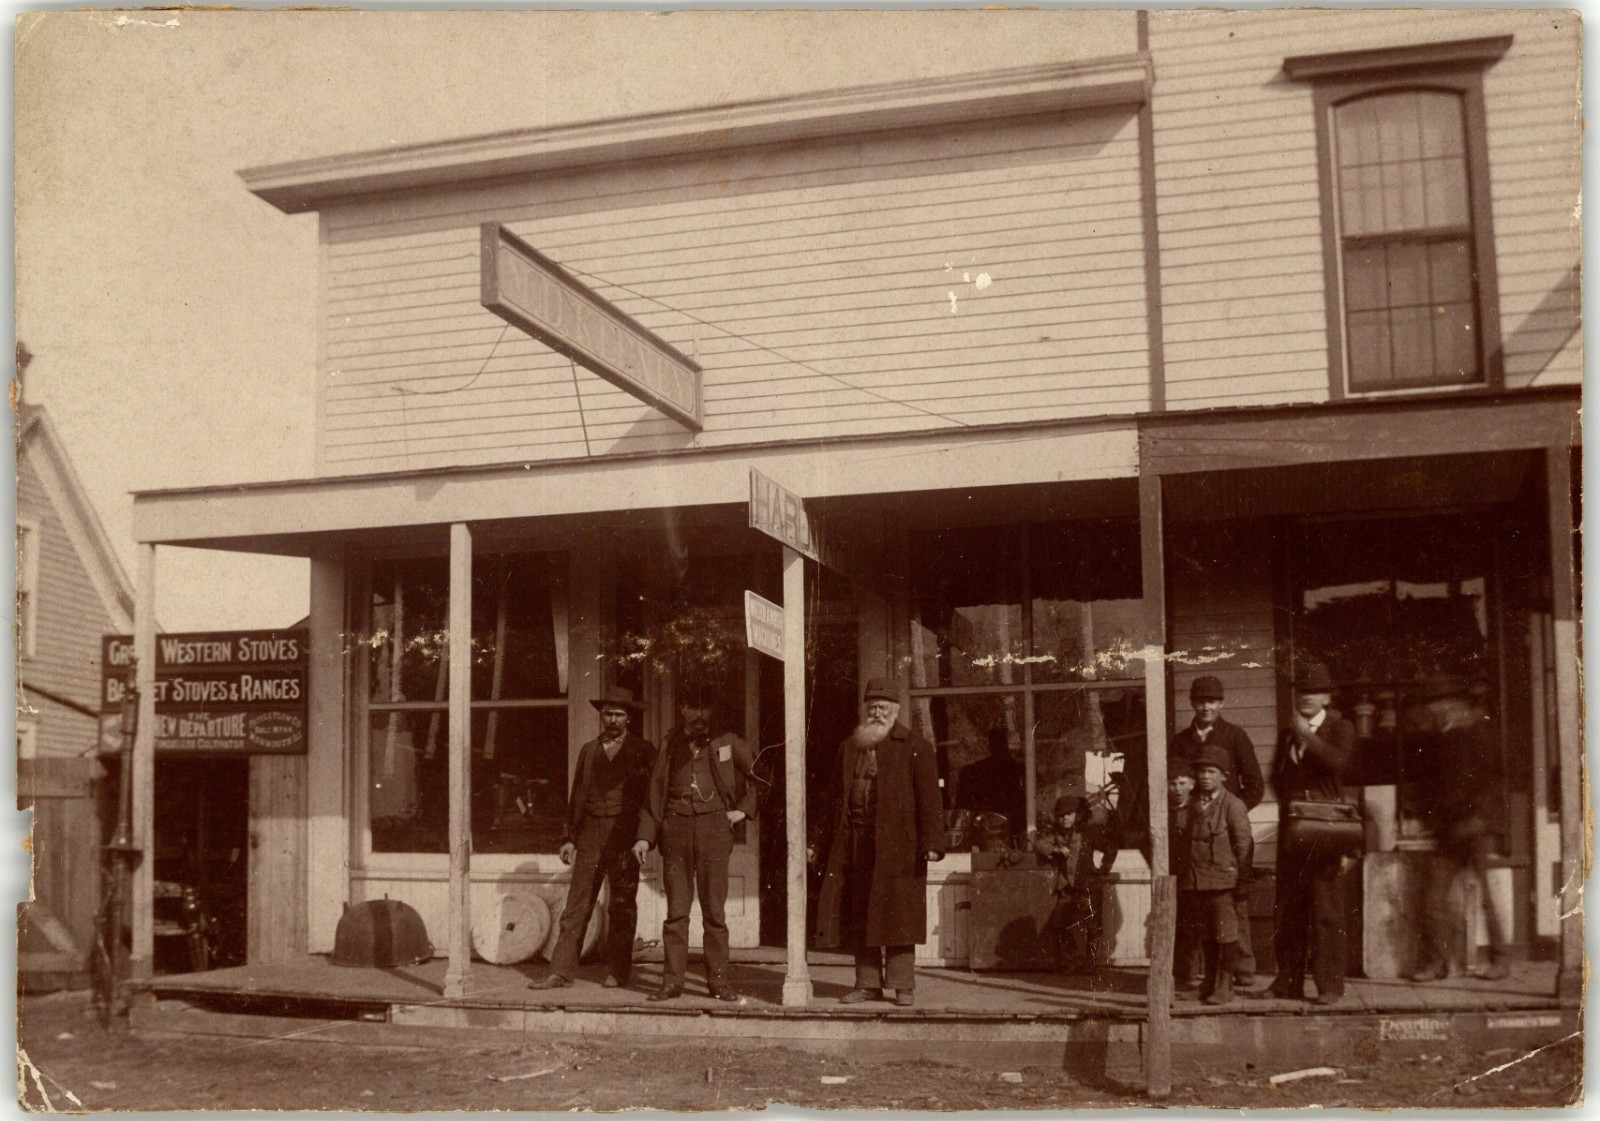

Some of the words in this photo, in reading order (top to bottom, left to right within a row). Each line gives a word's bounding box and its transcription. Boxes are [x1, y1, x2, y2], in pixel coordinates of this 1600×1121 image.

[160, 639, 232, 664] WESTERN
[238, 637, 299, 661] STOVES
[172, 677, 228, 702] STOVES
[229, 682, 239, 701] &
[240, 674, 300, 702] RANGES
[178, 711, 247, 738] DEPARTURE
